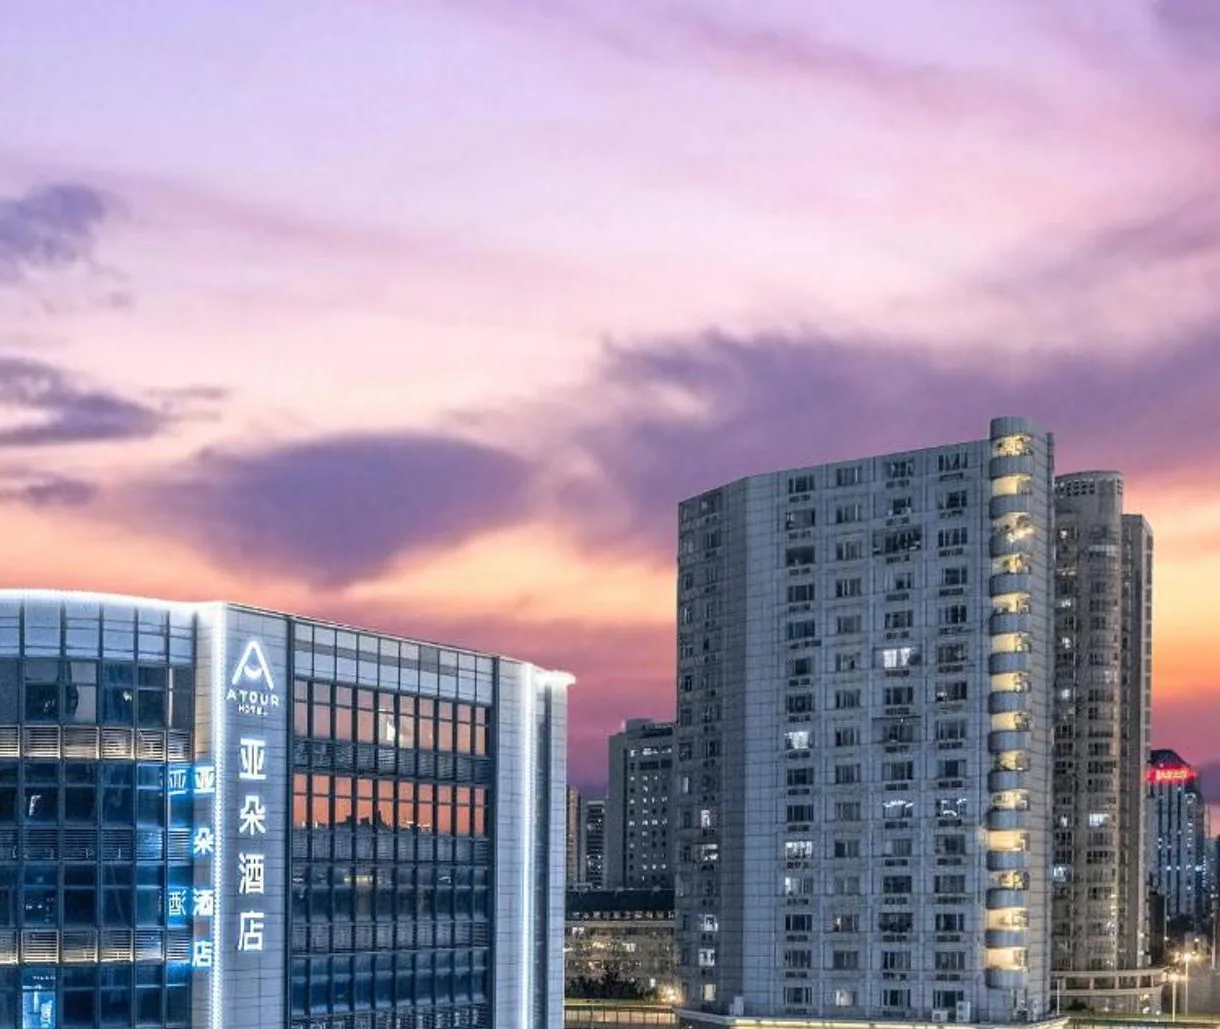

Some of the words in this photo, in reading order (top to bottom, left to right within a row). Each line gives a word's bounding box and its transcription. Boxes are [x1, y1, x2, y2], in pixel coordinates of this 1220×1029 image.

[226, 688, 280, 707] ATOUR
[192, 765, 215, 968] 亚朵酒店
[237, 737, 267, 951] 亚朵酒店
